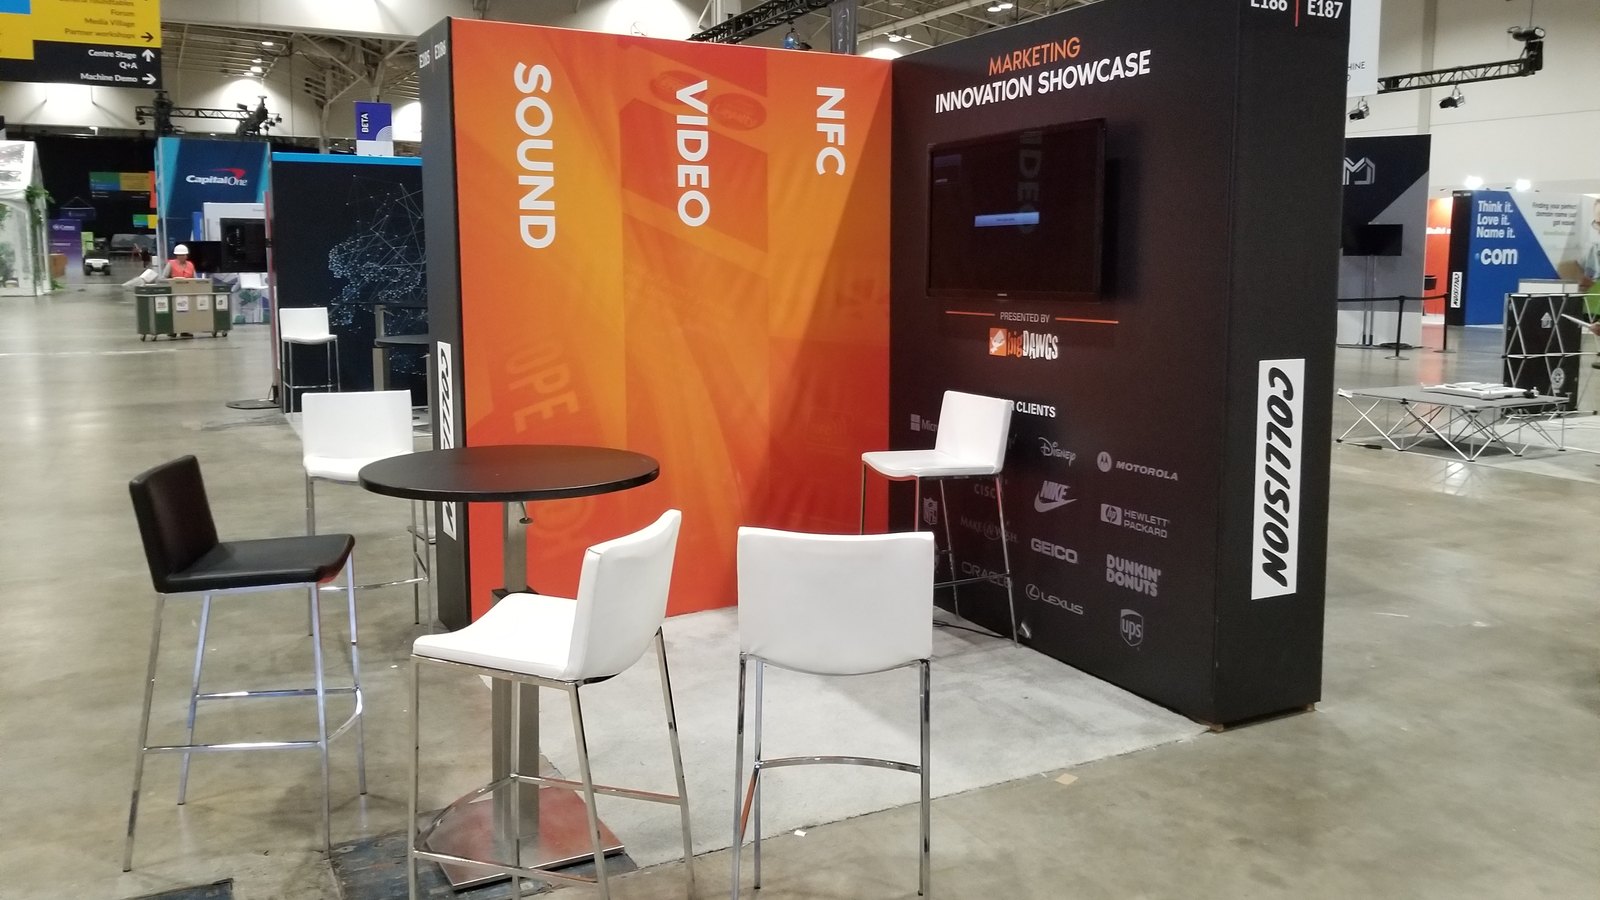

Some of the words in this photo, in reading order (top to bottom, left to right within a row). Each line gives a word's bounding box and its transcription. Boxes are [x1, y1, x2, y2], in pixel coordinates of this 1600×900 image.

[1307, 0, 1343, 19] E187
[88, 49, 115, 58] Centre
[115, 50, 137, 60] Stage
[989, 37, 1081, 76] MARKETING
[119, 61, 138, 70] Q+A
[80, 73, 114, 82] Machine
[114, 74, 138, 82] Demo
[935, 75, 1033, 114] INNOVATION
[1037, 50, 1152, 95] SHOWCASE
[361, 112, 369, 133] BETA
[816, 86, 846, 176] NFC
[513, 61, 556, 249] SOUND
[675, 80, 711, 227] VIDEO
[1478, 200, 1503, 213] Think
[1504, 201, 1514, 213] it.
[1476, 213, 1499, 226] Love
[1500, 214, 1511, 226] it.
[1476, 226, 1506, 239] Name
[1506, 226, 1516, 239] it.
[1000, 311, 1040, 323] PRESENTED
[1040, 314, 1050, 323] BY
[1016, 401, 1056, 418] CLIENTS
[1115, 460, 1179, 481] MOTOROLA
[1261, 366, 1294, 588] COLLISION
[974, 483, 1002, 500] CISC
[1040, 480, 1071, 501] NIKE
[1123, 509, 1170, 527] HEWLETT
[1123, 520, 1168, 539] PACKARD
[1031, 538, 1079, 564] GEICO
[1106, 553, 1161, 583] DUNKIN'
[1106, 568, 1158, 597] DONUTS
[1041, 591, 1084, 616] LEXUS
[1121, 618, 1142, 641] ups
